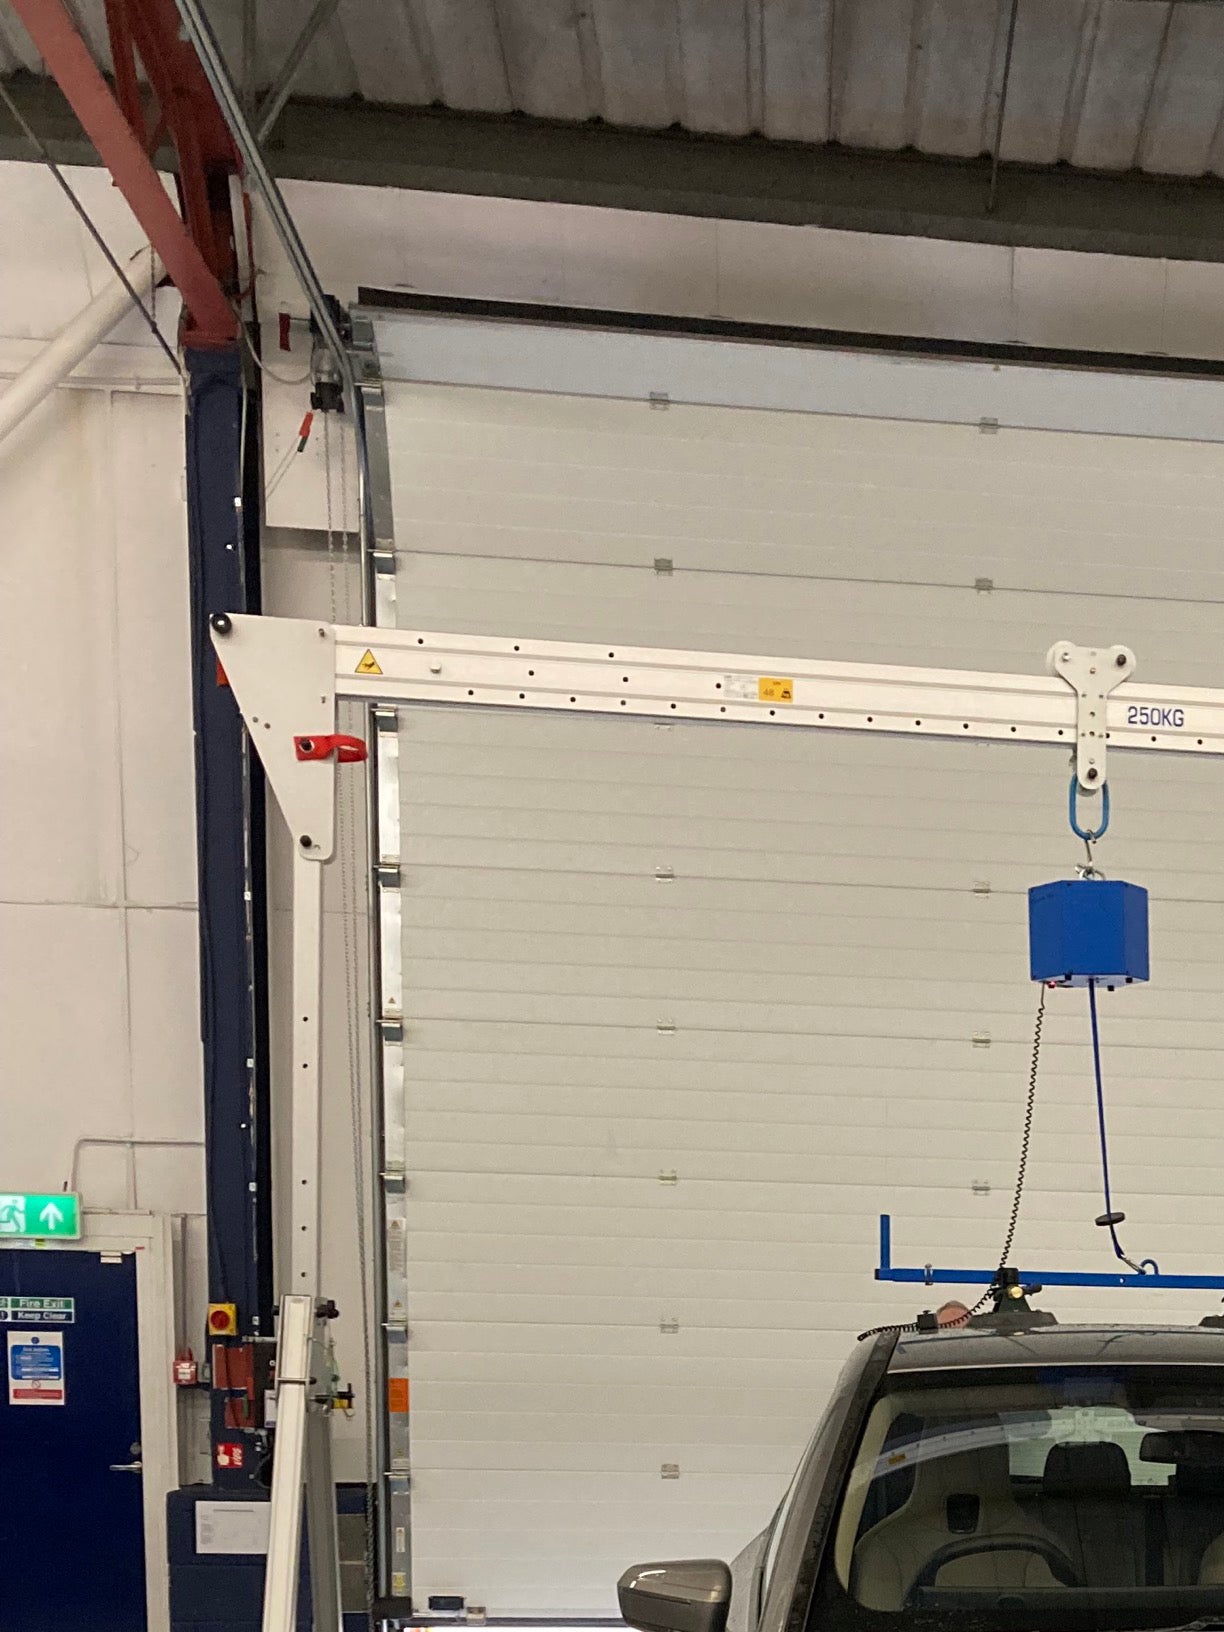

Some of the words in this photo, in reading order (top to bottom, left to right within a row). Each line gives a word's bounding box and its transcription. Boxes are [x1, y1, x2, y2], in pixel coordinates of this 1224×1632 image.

[1128, 706, 1184, 727] 250KG
[19, 1299, 41, 1308] Fire
[43, 1299, 64, 1309] Exit
[18, 1311, 41, 1320] Keep
[43, 1312, 67, 1320] Clear
